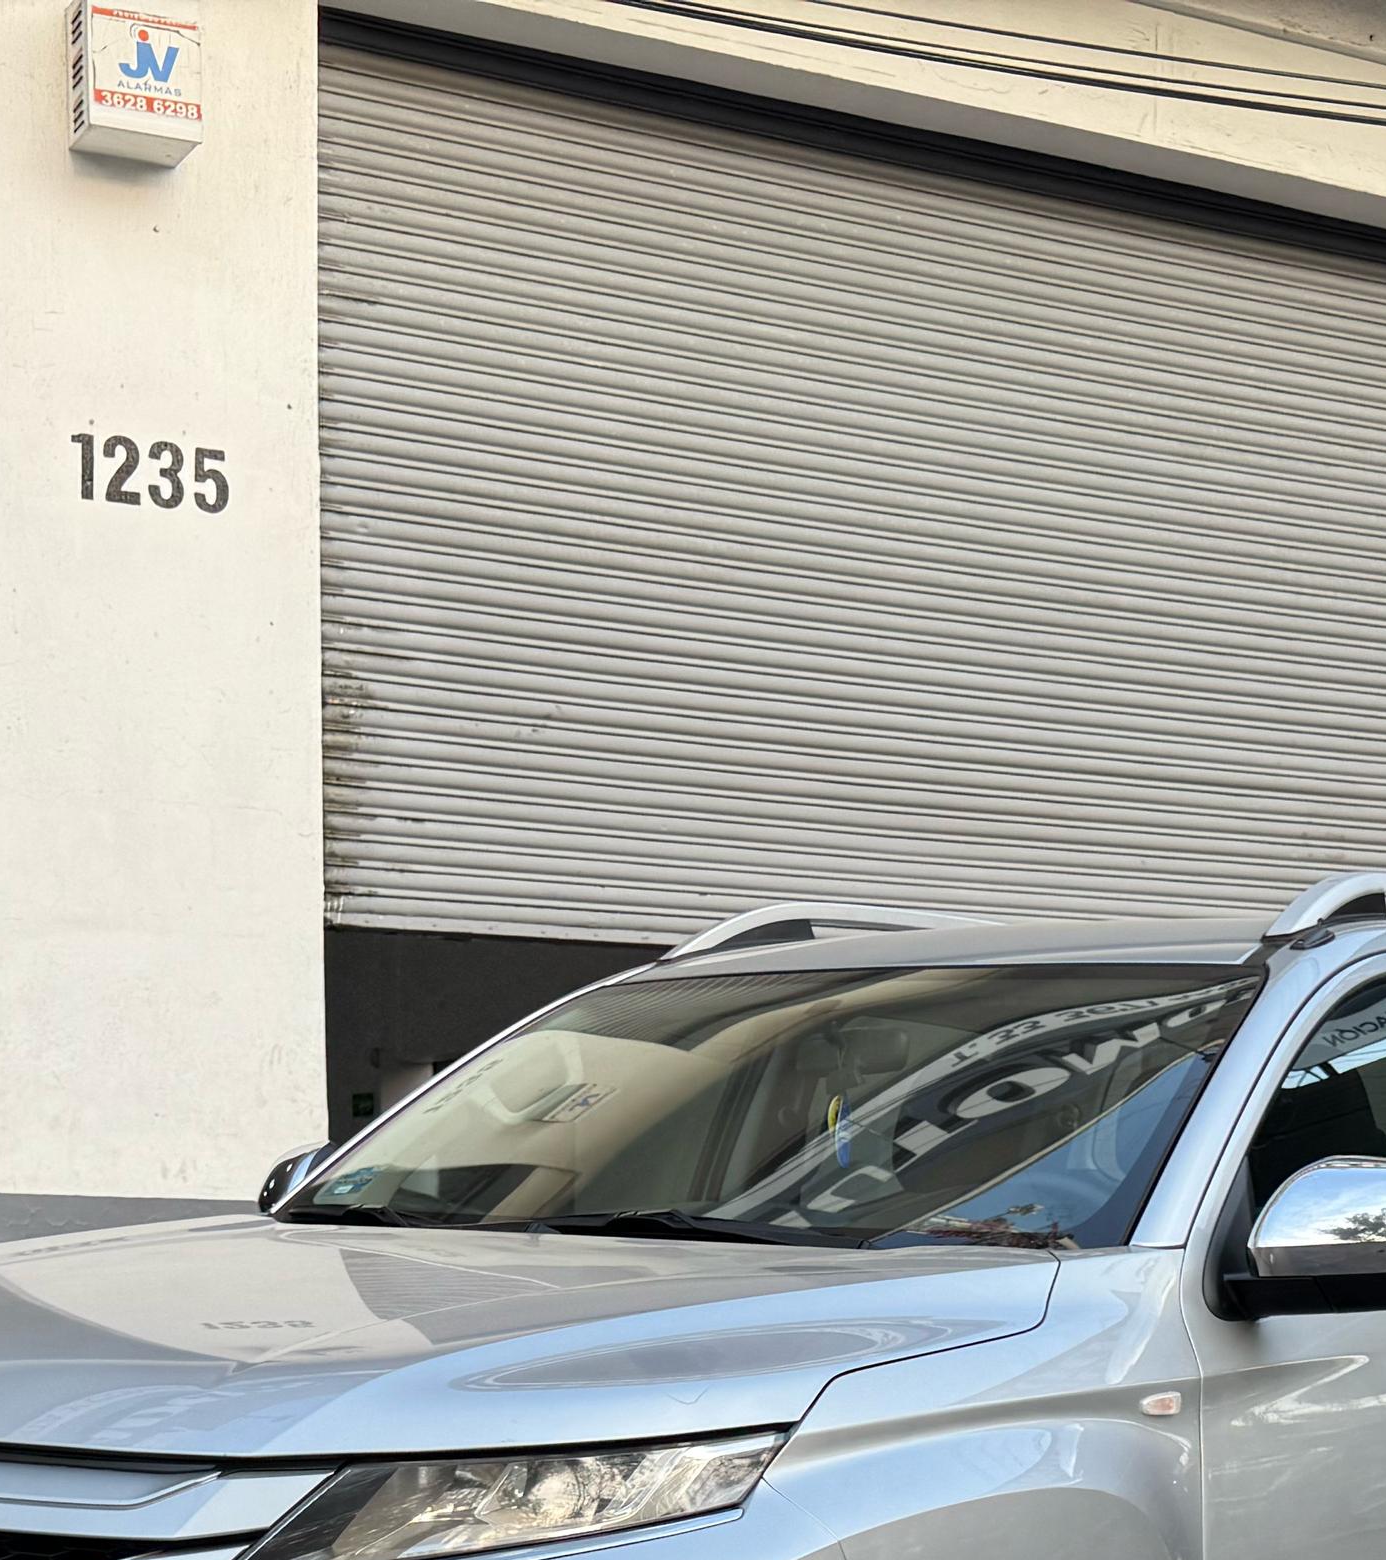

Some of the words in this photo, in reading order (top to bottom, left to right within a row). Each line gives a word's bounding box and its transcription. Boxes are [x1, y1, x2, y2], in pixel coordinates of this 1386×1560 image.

[116, 80, 182, 98] ALARMAS
[100, 91, 147, 112] 3628
[152, 99, 199, 120] 6298
[70, 432, 229, 514] 1235
